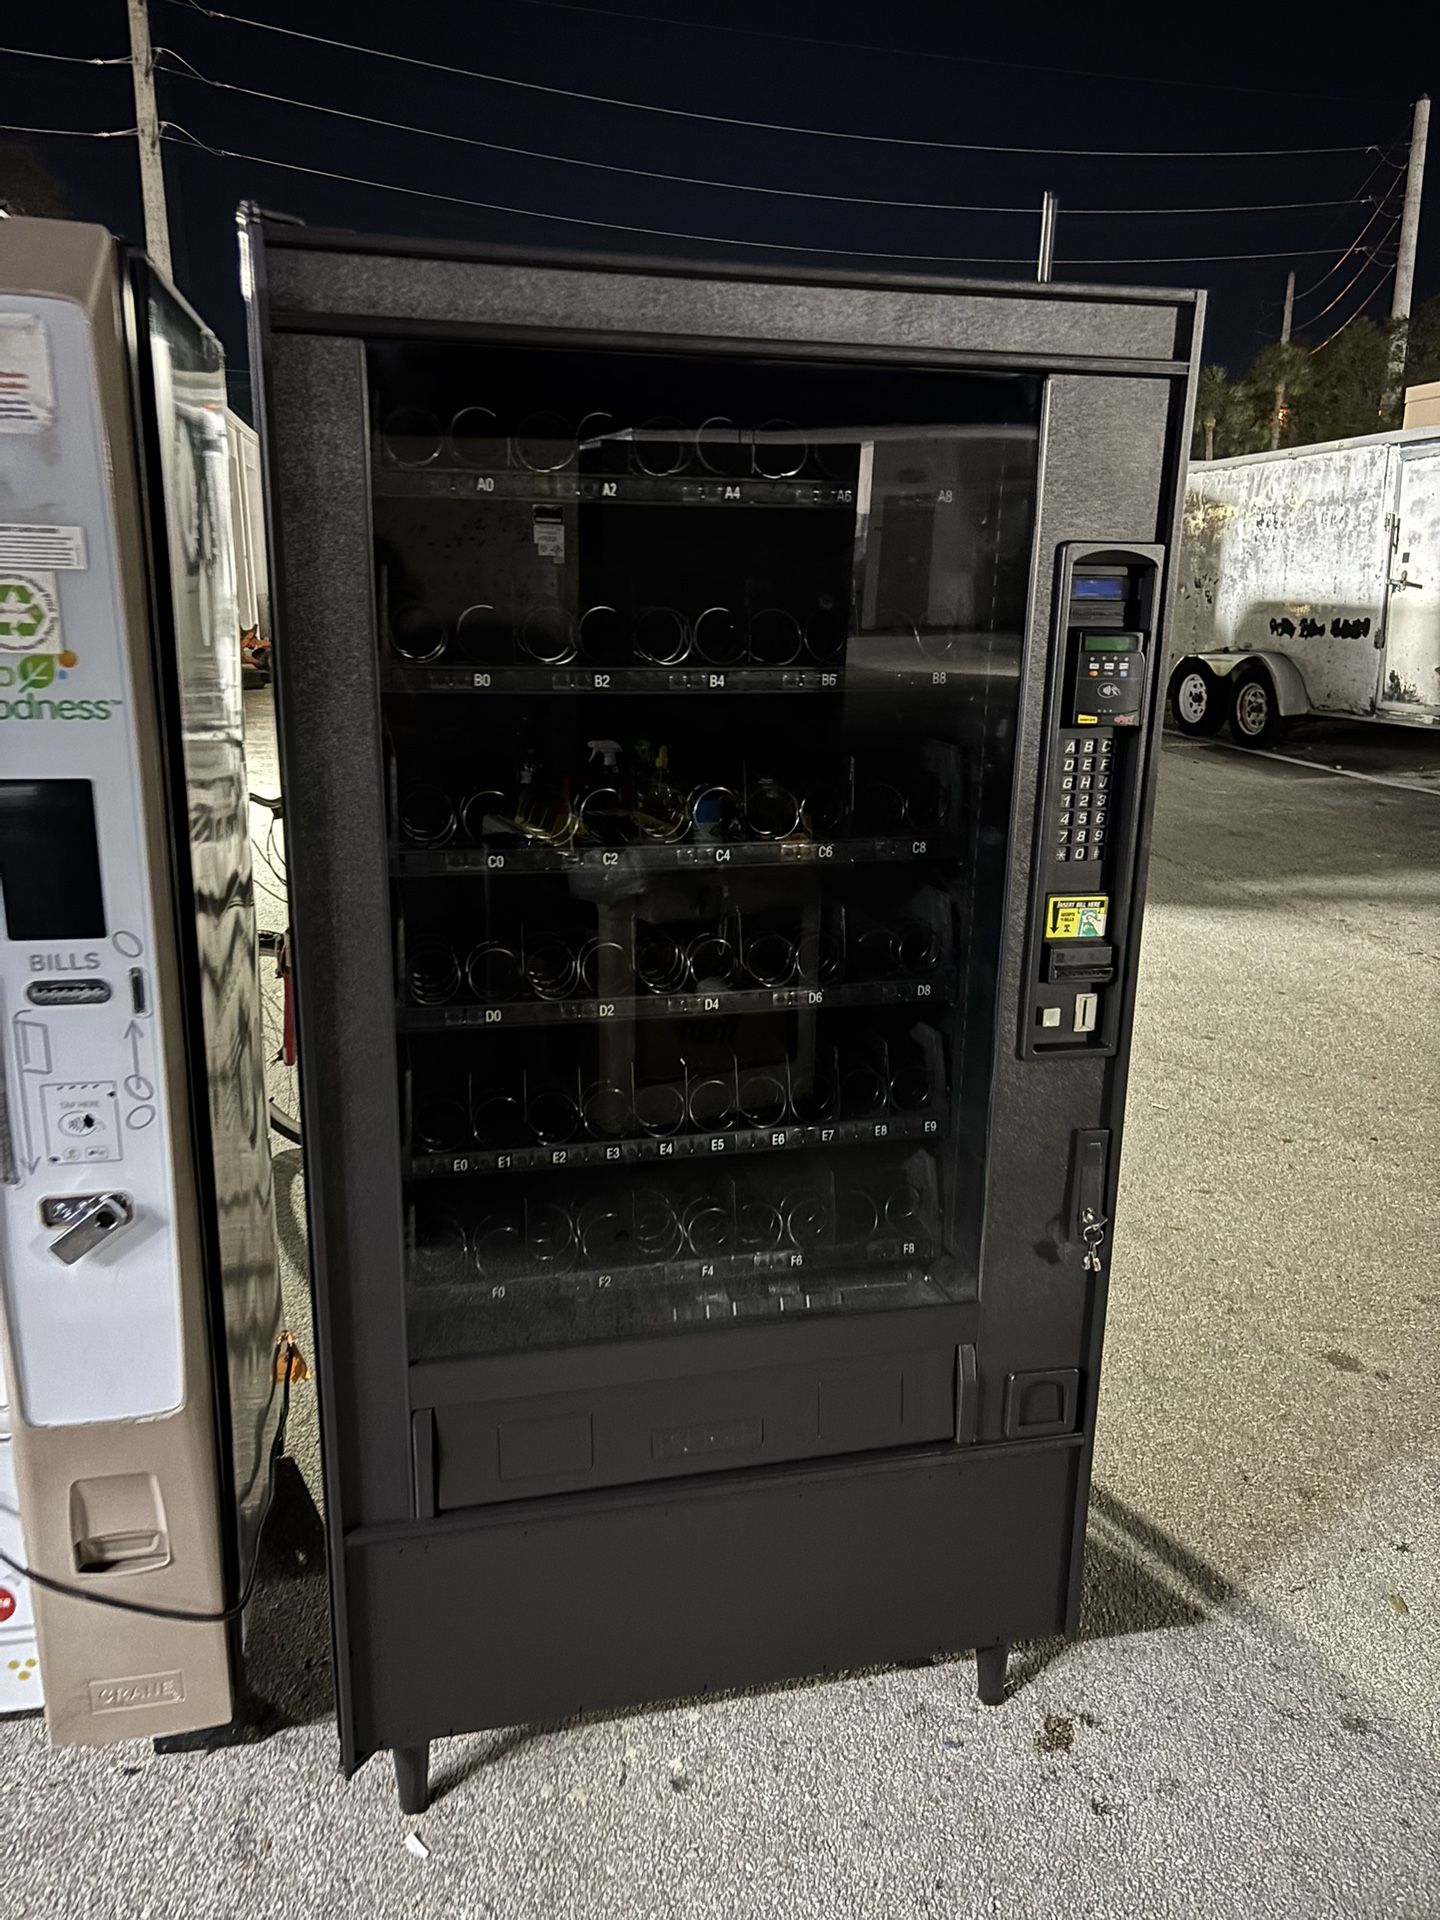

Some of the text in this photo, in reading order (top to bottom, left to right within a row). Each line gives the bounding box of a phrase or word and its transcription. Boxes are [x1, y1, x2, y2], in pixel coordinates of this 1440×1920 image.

[476, 478, 494, 492] A0
[602, 483, 617, 496] A2
[724, 487, 741, 499] A4
[938, 490, 953, 503] A8
[474, 672, 946, 688] B0 B2 B4 B6 B8
[1065, 740, 1111, 754] A B C
[1064, 759, 1109, 771] D E F
[1063, 776, 1108, 789] G H J
[1063, 794, 1106, 807] 1 2 3
[1060, 812, 1104, 824] 4 5 6
[1060, 830, 1103, 842] 7 8 9
[487, 842, 926, 868] C0 C2 C4 C6 C8
[29, 952, 100, 972] BILLS
[486, 985, 931, 1022] D0 D2 D4 D6 D8
[454, 1121, 937, 1172] E0 E1 E2 E3 E4 E5 E6 E7 E8 E9
[492, 1243, 915, 1299] F0 F2 F4 F6 F8
[99, 1679, 176, 1704] CRANE
